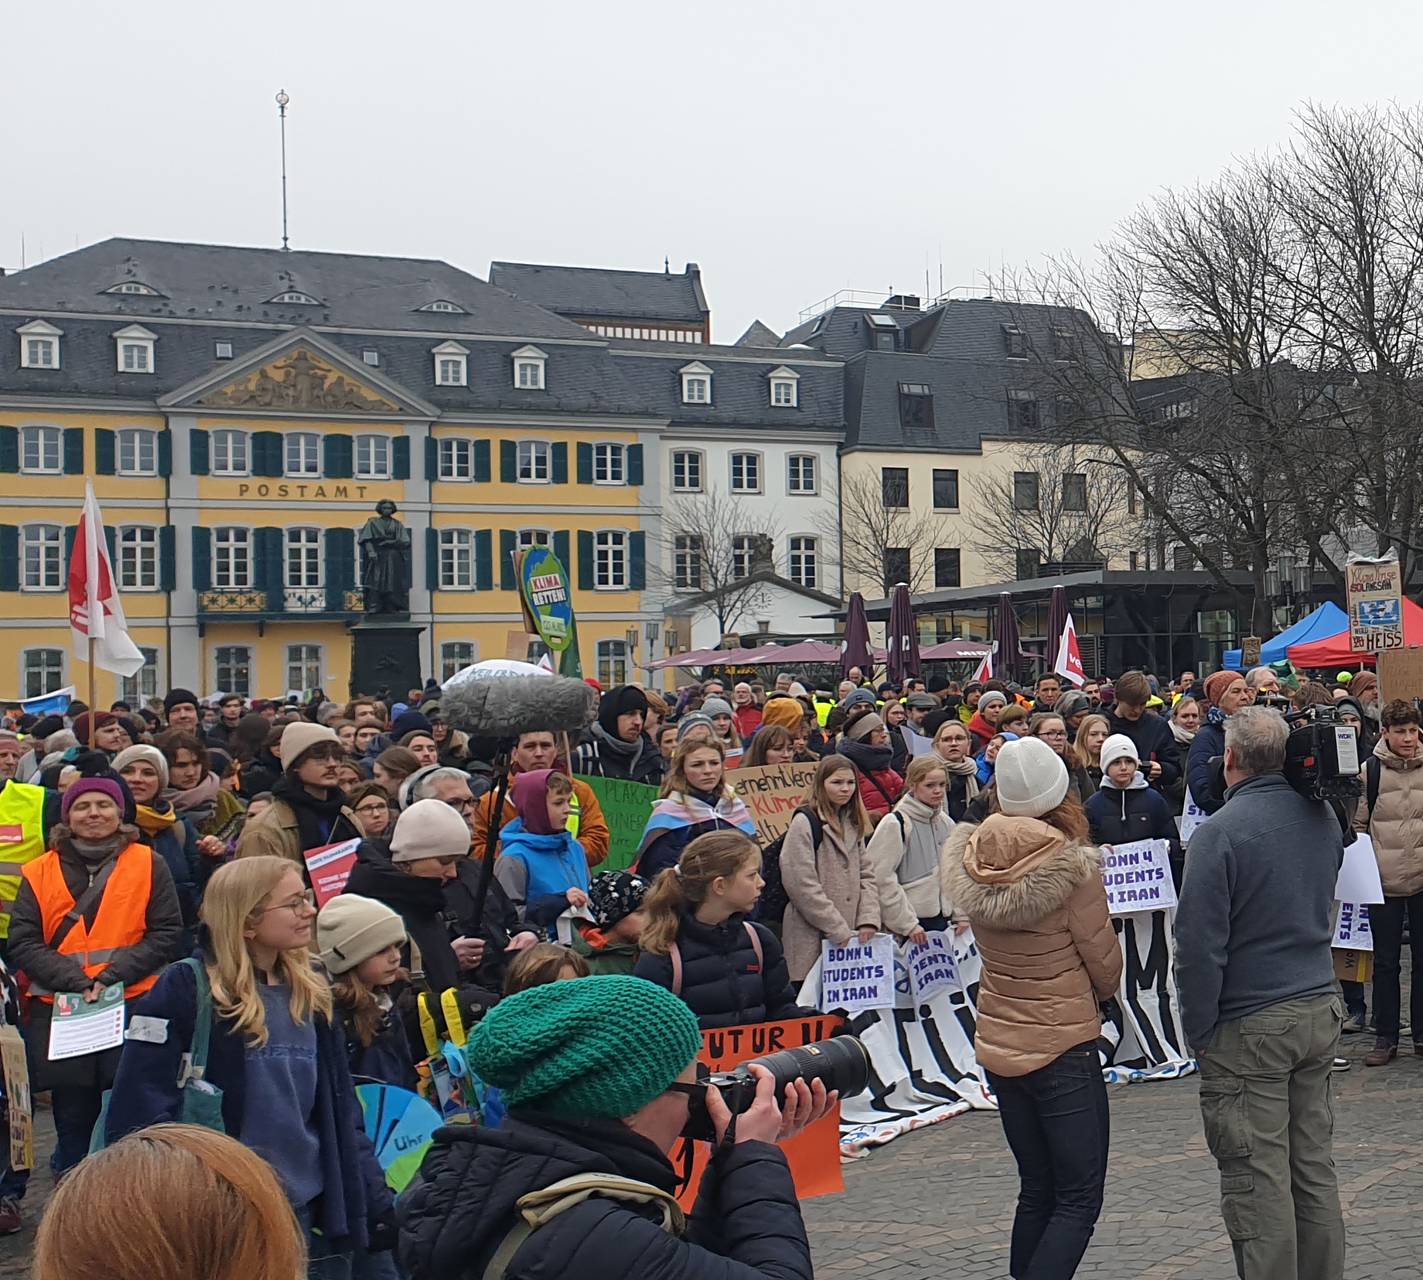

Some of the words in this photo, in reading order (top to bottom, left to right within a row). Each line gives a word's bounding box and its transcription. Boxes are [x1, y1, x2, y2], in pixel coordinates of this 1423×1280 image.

[239, 484, 368, 498] POSTAMT
[532, 574, 561, 590] KLIMA
[533, 588, 567, 606] RETTEN!
[1366, 631, 1402, 651] HEISS
[1143, 851, 1153, 863] 4
[1104, 868, 1165, 887] UDENTS
[1117, 886, 1160, 903] IRAN
[1339, 902, 1354, 940] ENTS
[932, 938, 943, 950] 4
[828, 948, 863, 962] BONN
[864, 946, 873, 959] 4
[913, 954, 955, 976] ENTS
[823, 965, 885, 984] STUDENTS
[918, 968, 955, 991] IRAN
[827, 990, 840, 1003] IN
[842, 986, 878, 1001] IRAN
[394, 1135, 423, 1151] Uhr
